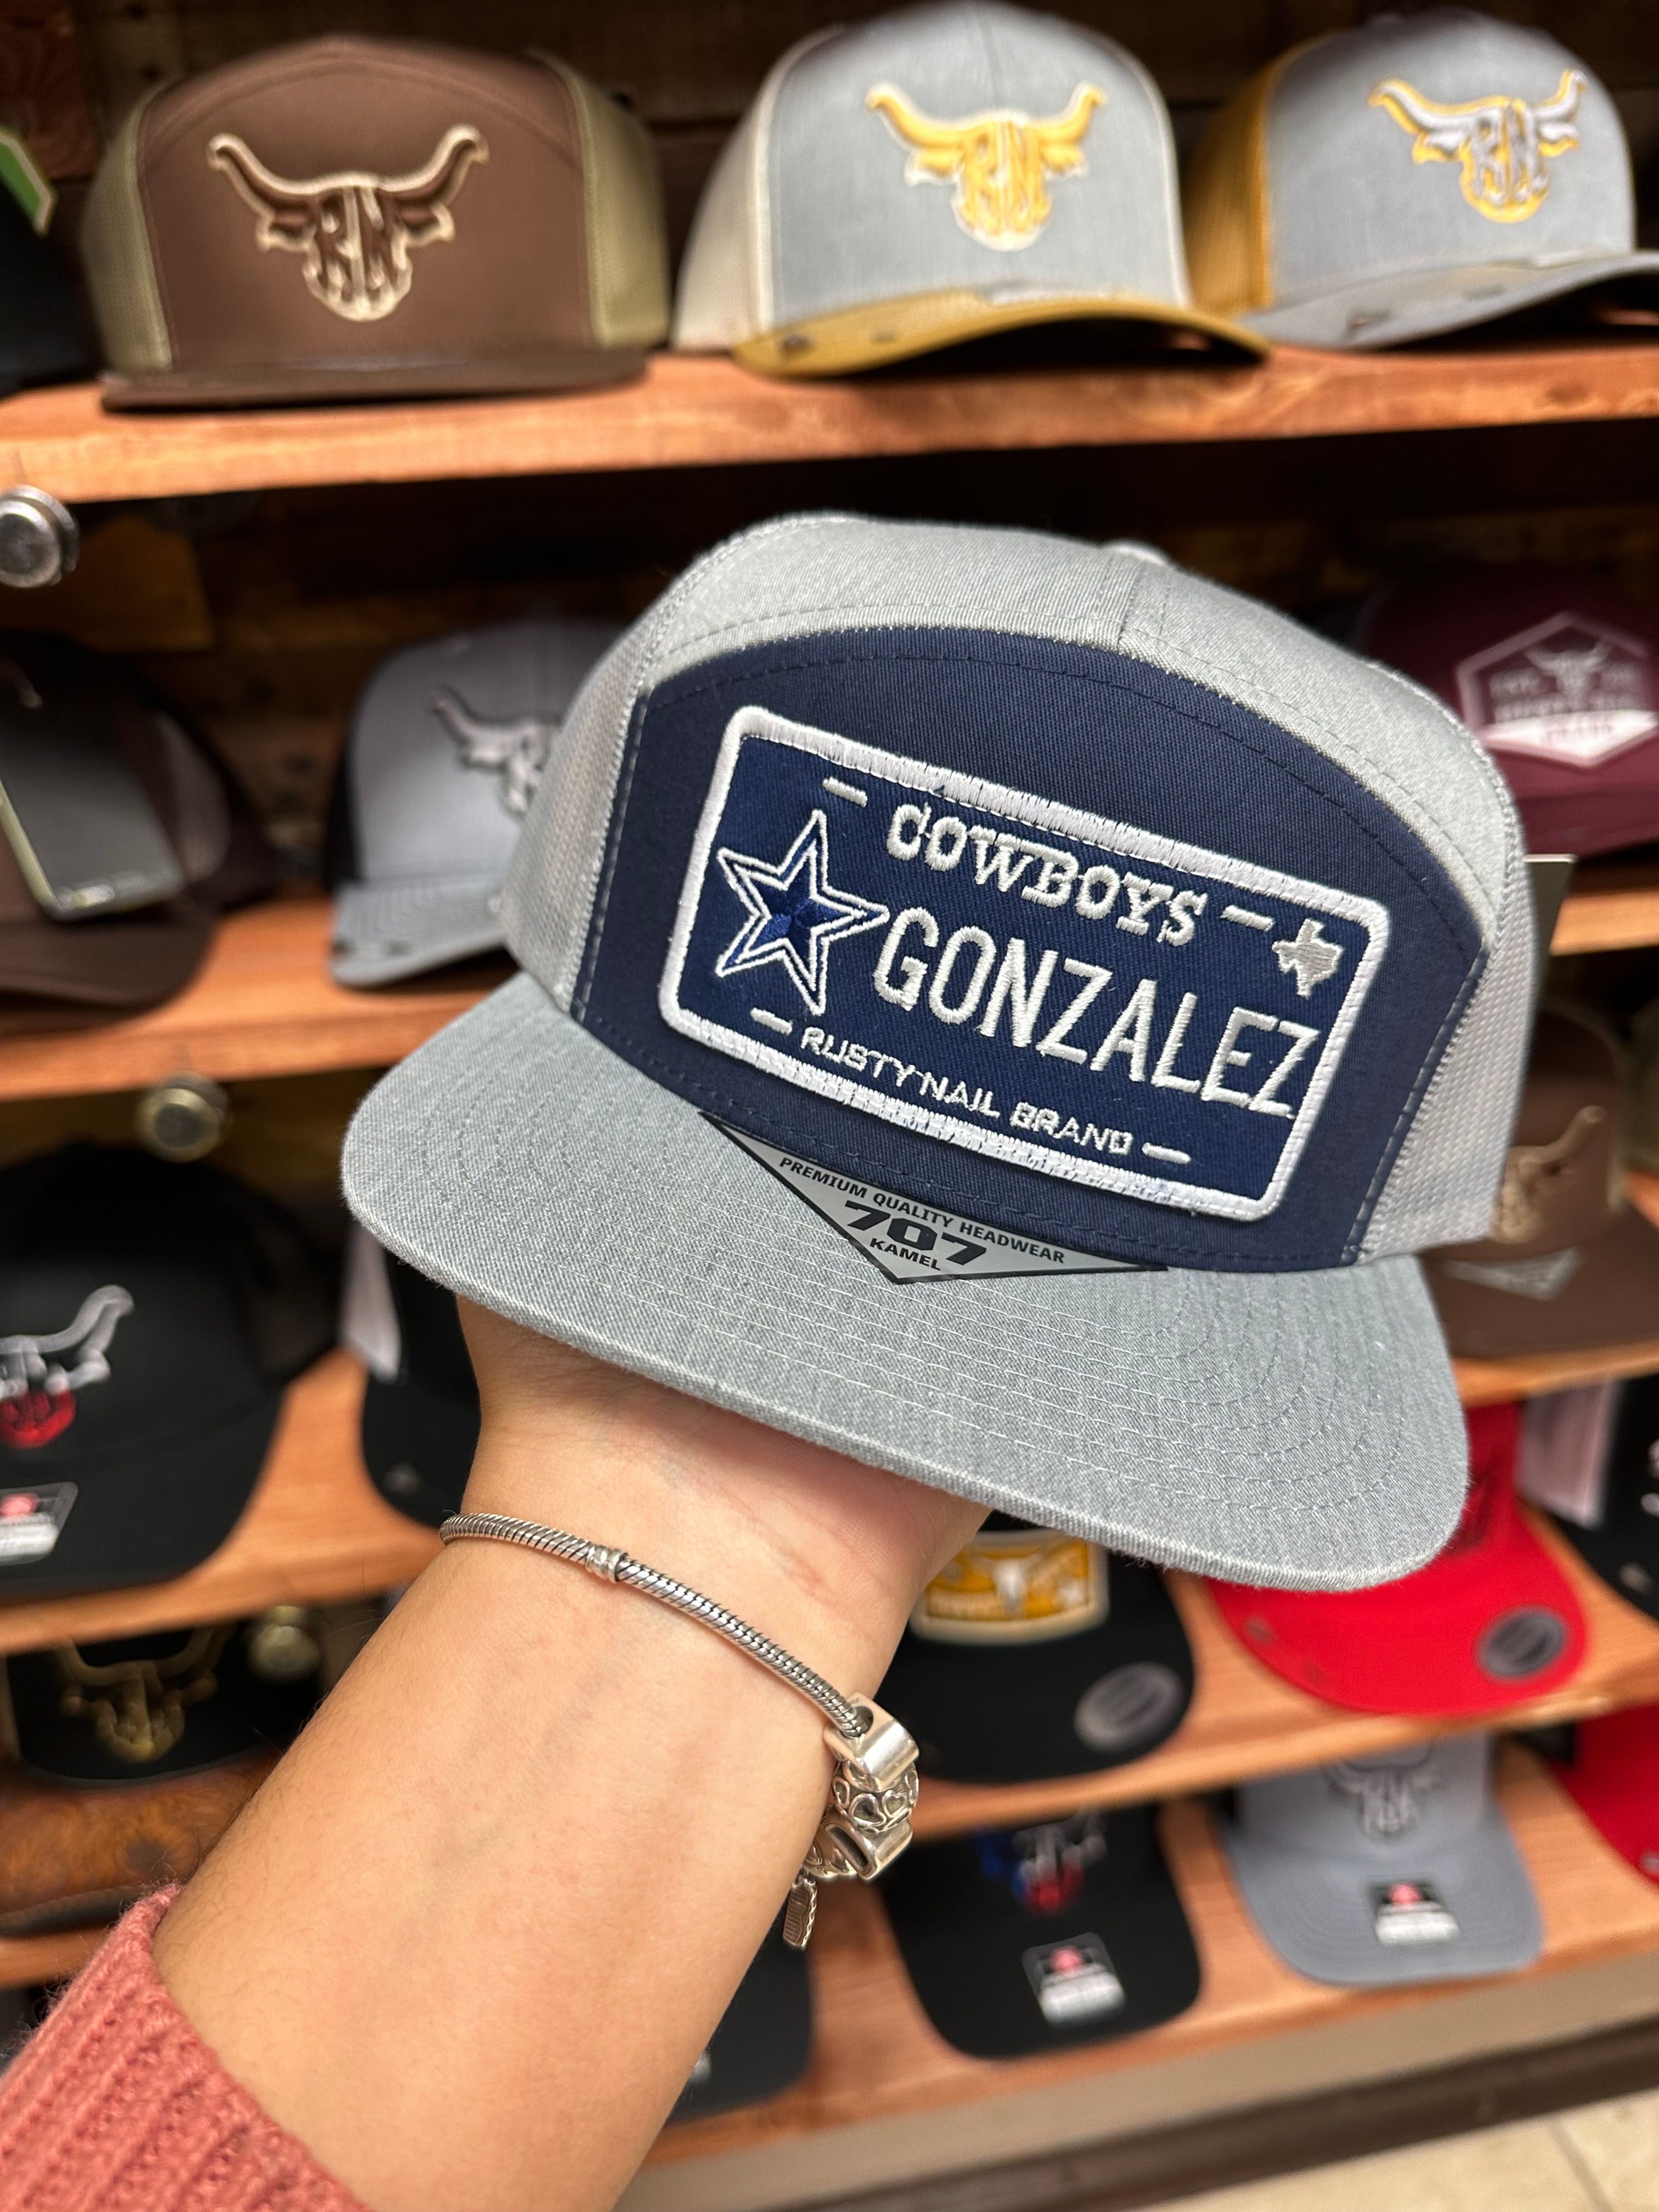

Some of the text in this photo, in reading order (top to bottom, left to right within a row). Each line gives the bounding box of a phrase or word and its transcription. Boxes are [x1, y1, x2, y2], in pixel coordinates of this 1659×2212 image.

[887, 803, 1207, 946] COWBOYS
[873, 906, 1320, 1120] GONZALEZ
[800, 1026, 1134, 1155] RUSTY NAIL BRAND
[780, 1157, 1064, 1263] PREMIUM QUALITY HEADWEAR
[845, 1200, 986, 1265] 707
[870, 1238, 940, 1271] KAMEL
